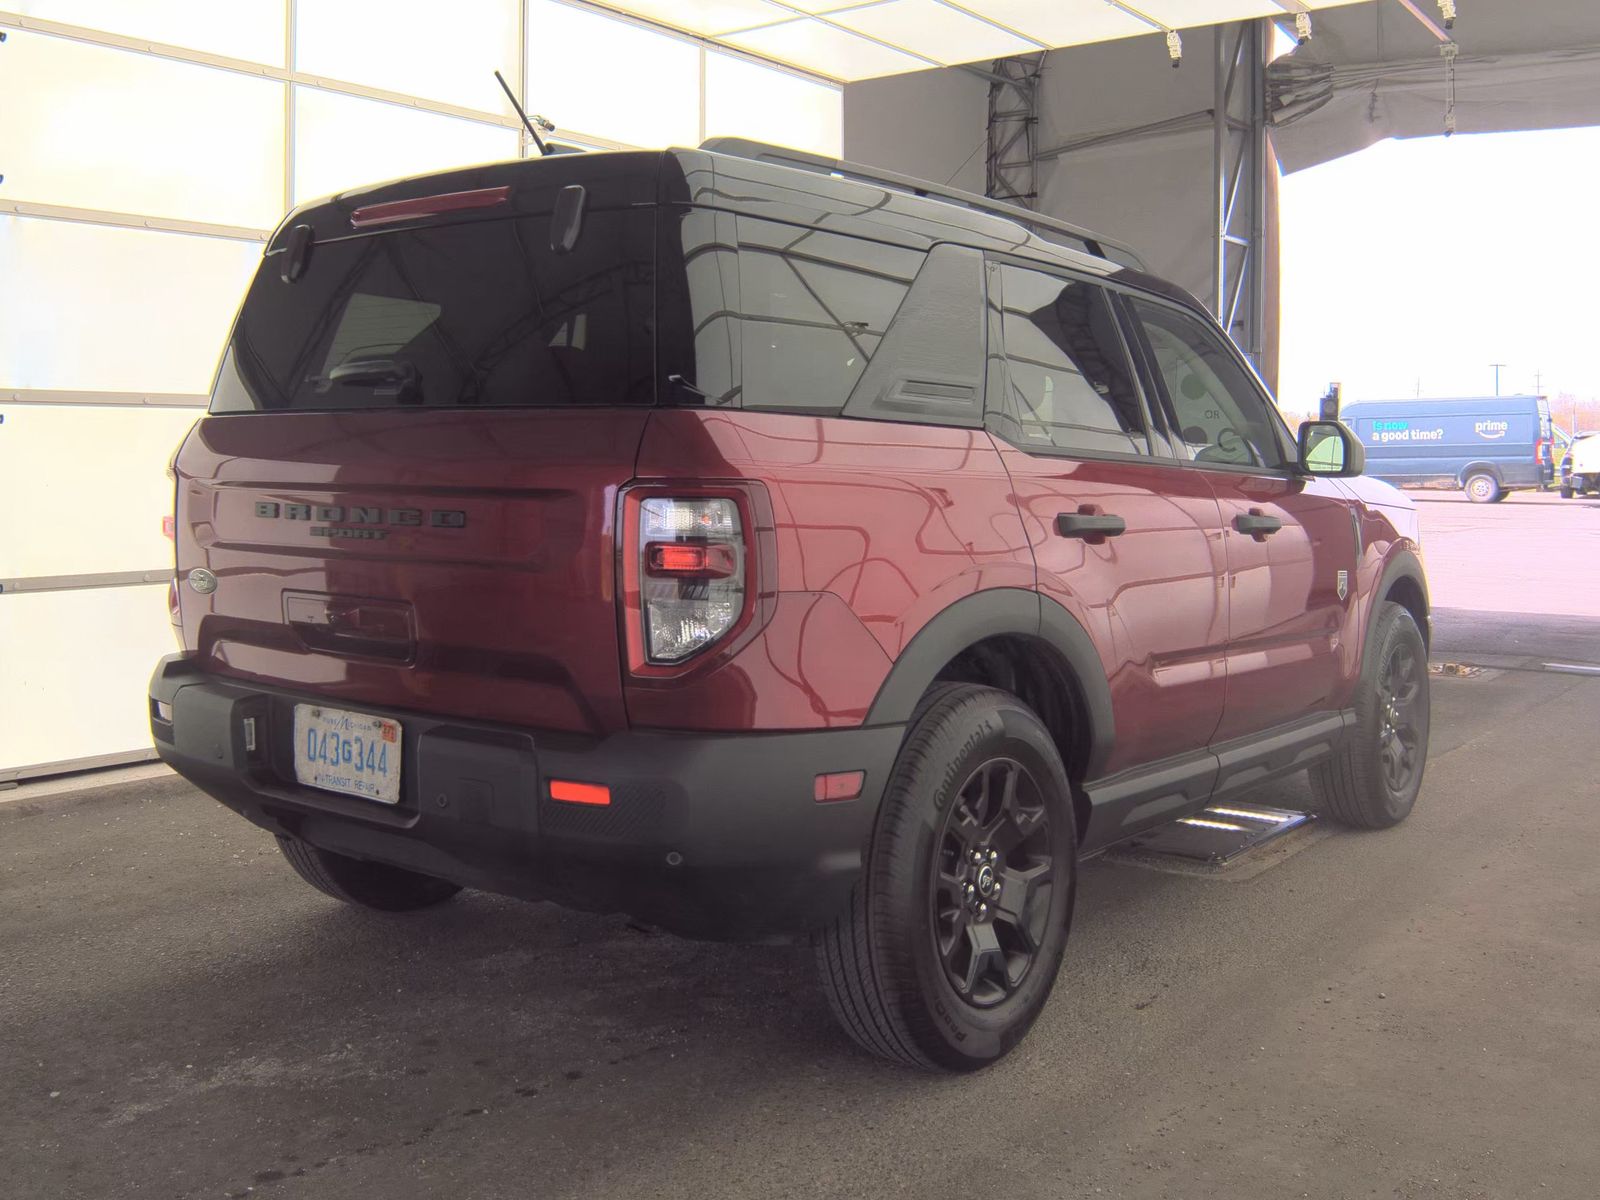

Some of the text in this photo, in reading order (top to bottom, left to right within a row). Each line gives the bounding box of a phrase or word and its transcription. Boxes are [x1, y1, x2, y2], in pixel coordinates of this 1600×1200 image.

[1372, 420, 1408, 431] is now
[1474, 420, 1508, 433] prime
[1372, 428, 1444, 442] a good time?
[255, 501, 465, 528] BRONCO
[309, 526, 390, 540] SPORT
[307, 727, 388, 778] 043G344
[933, 724, 985, 811] Continental
